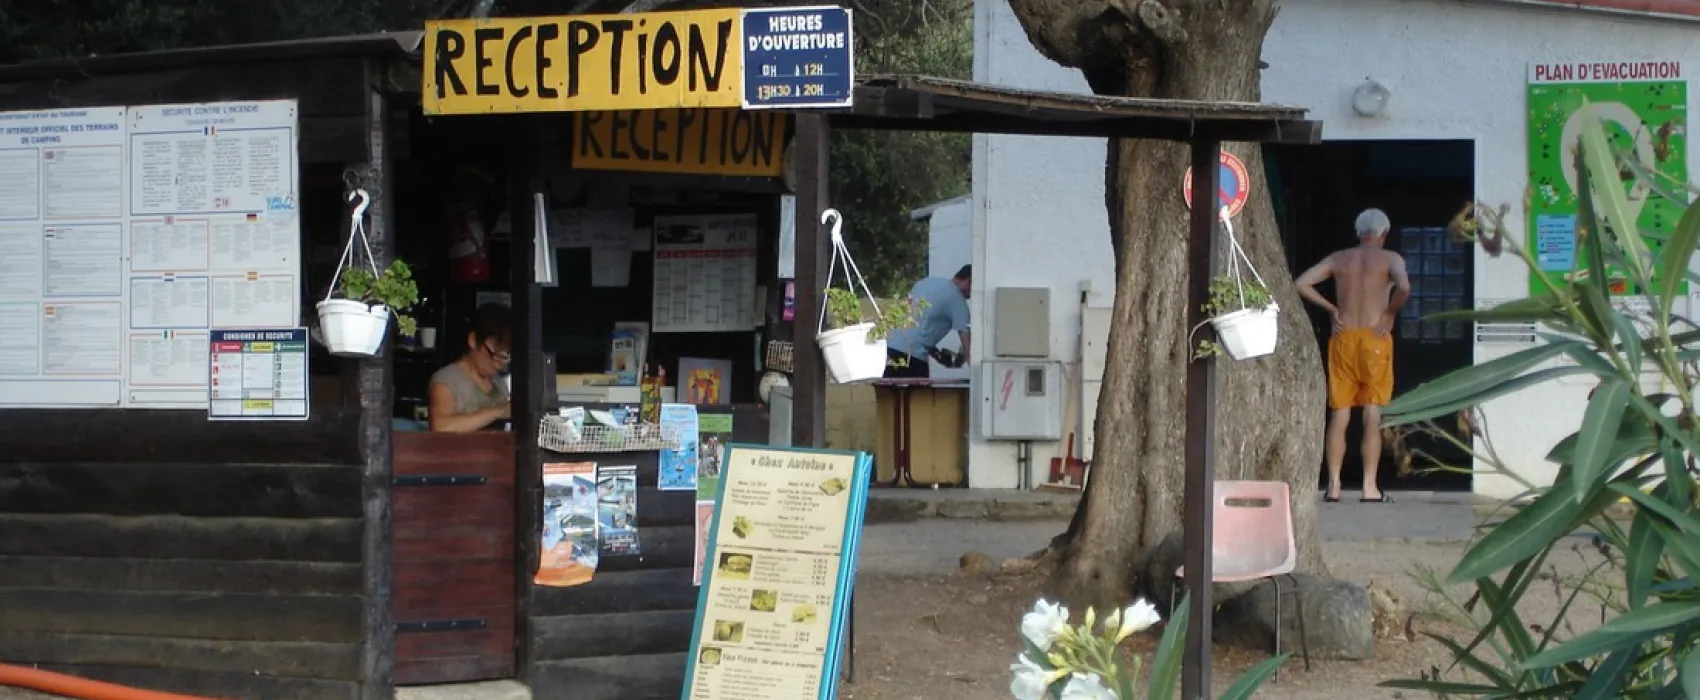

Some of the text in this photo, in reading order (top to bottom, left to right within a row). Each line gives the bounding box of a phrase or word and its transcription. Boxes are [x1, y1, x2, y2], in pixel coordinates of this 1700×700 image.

[769, 14, 823, 32] HEURES
[748, 32, 845, 51] D'OUVERTURE
[804, 63, 823, 76] 12H
[1535, 61, 1681, 80] PLAN D'EVACUATION
[803, 83, 824, 97] 20H
